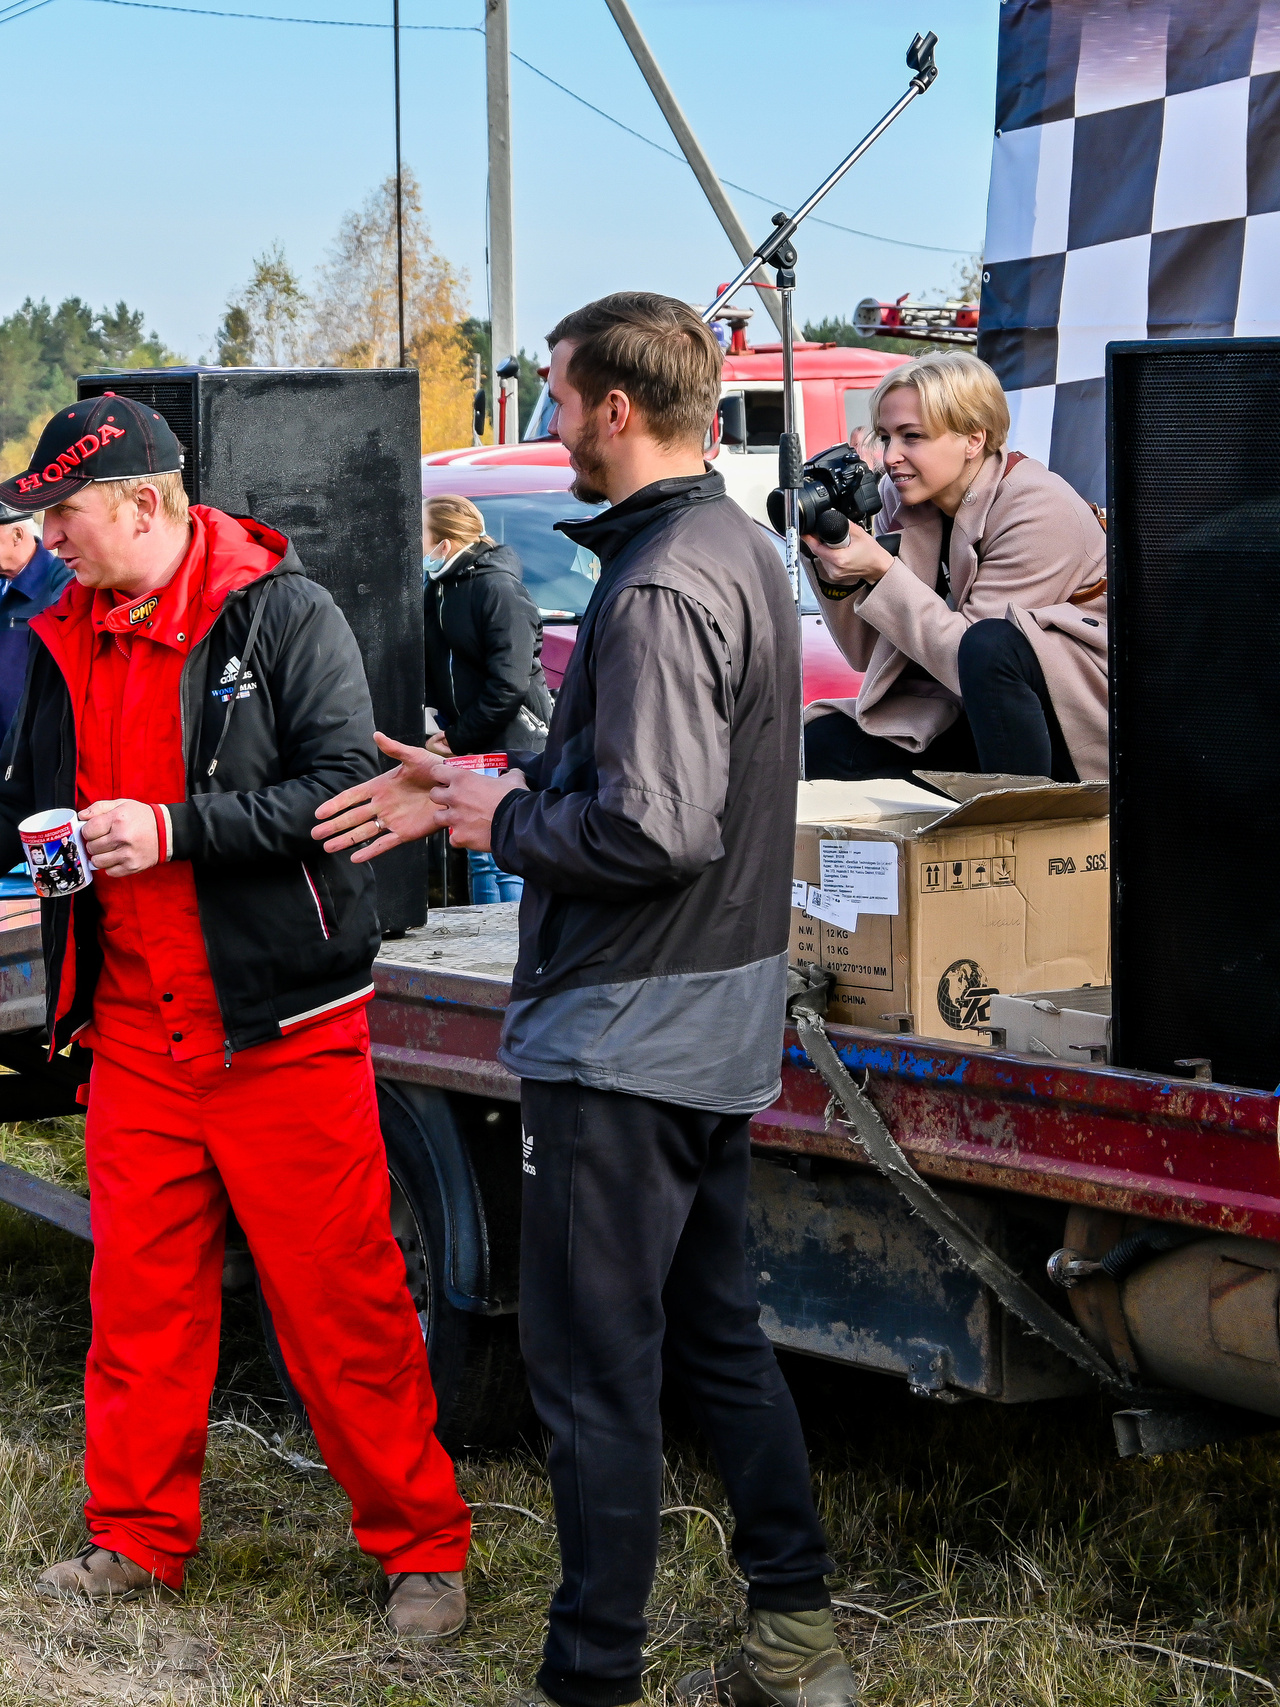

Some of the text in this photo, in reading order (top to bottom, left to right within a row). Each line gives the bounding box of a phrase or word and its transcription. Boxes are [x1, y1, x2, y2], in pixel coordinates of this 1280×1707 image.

[16, 424, 126, 493] HONDA
[132, 599, 158, 622] OMP
[1048, 853, 1107, 876] FDA SGS
[798, 925, 849, 939] N.W. 12 KG
[798, 941, 849, 955] G.W. 13 KG
[841, 994, 867, 1006] CHINA
